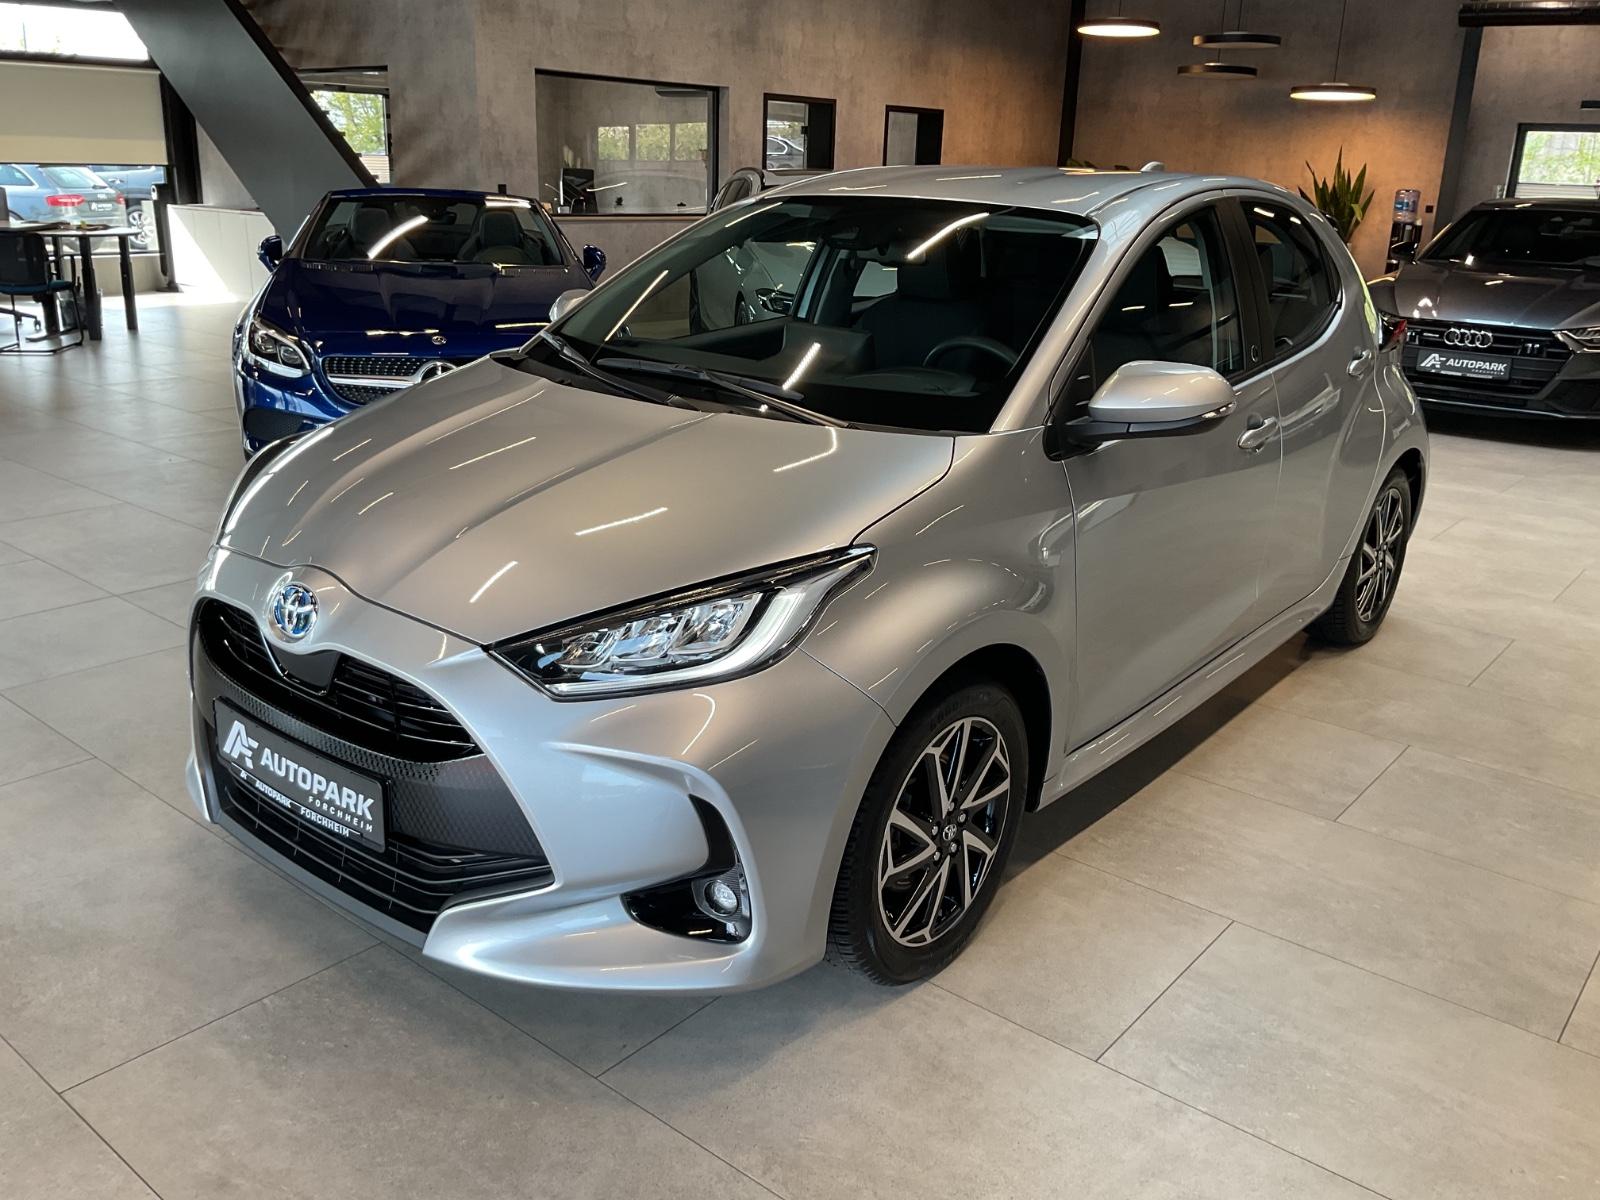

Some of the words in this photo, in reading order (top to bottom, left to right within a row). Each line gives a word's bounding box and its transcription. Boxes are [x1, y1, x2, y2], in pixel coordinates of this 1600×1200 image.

[1446, 358, 1507, 371] AUTOPARK
[260, 747, 374, 820] AUTOPARK
[255, 780, 291, 808] AUTOPARK
[300, 807, 349, 837] FORCHHEIM
[308, 796, 373, 833] FORCHHEIM
